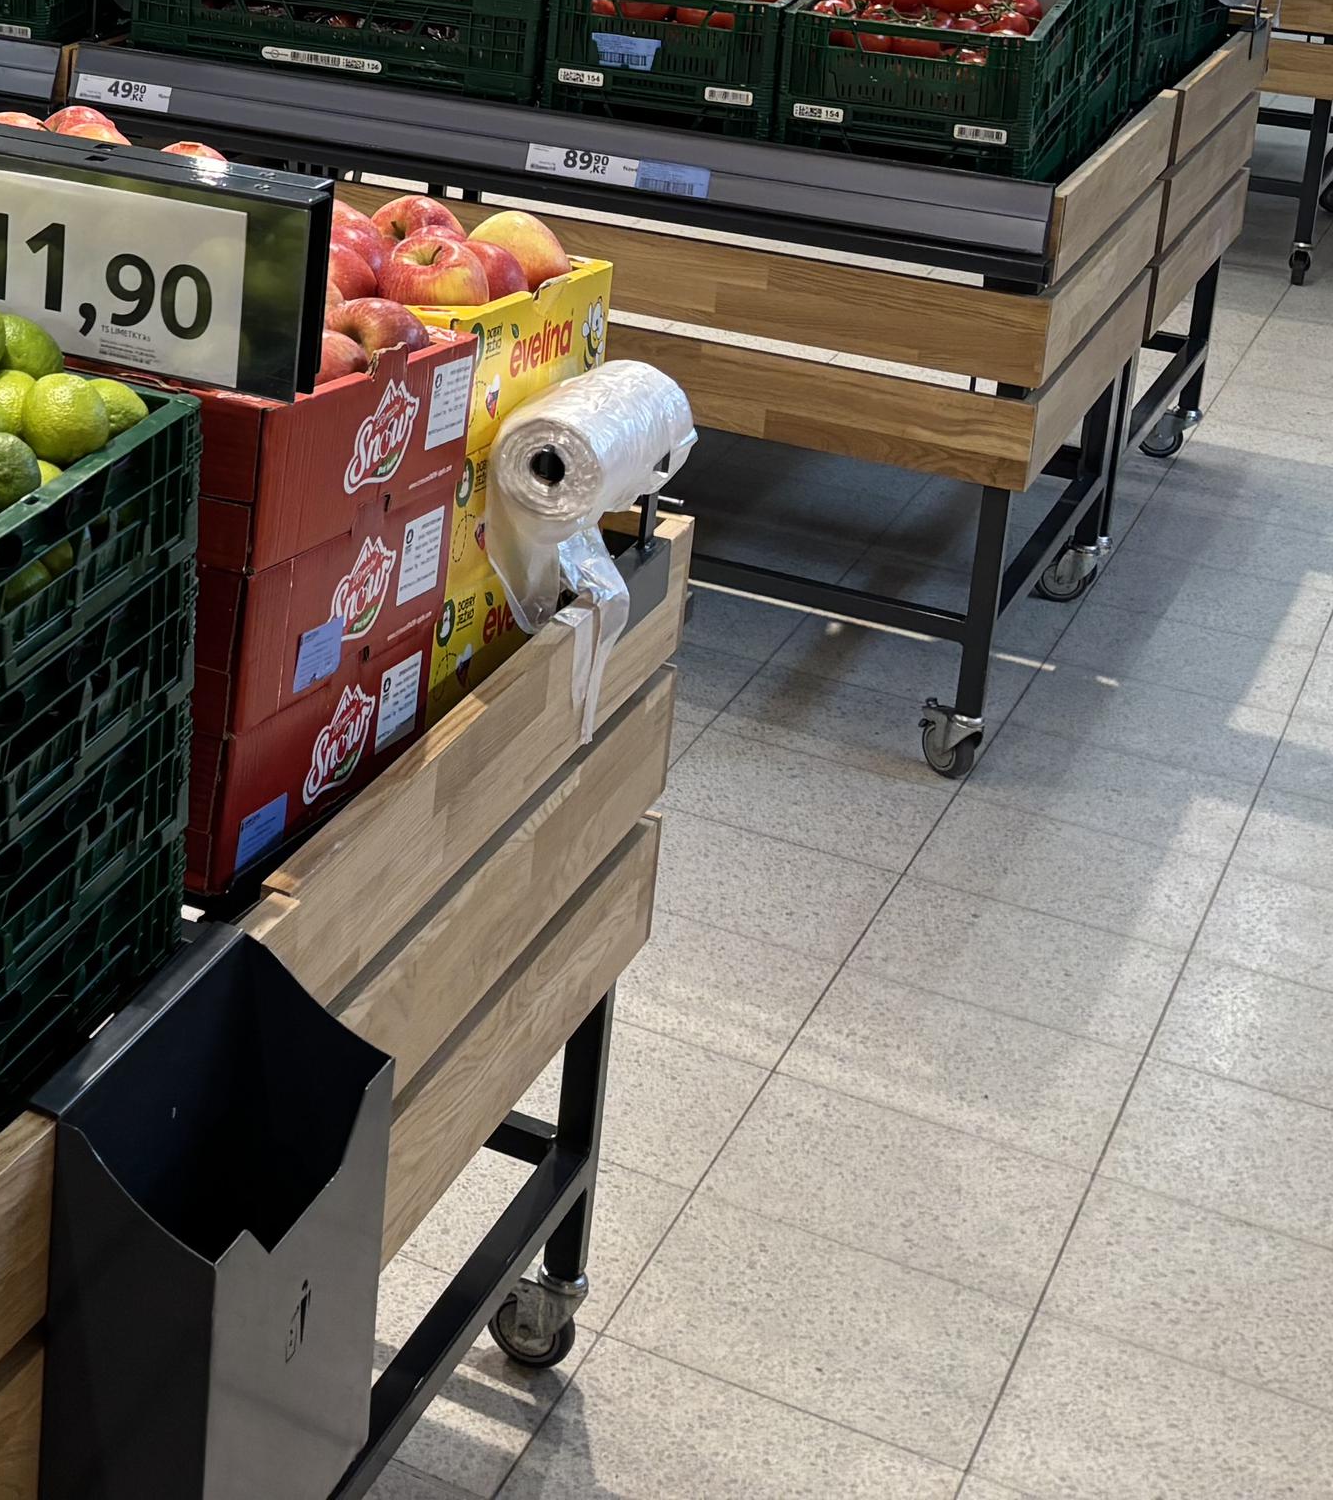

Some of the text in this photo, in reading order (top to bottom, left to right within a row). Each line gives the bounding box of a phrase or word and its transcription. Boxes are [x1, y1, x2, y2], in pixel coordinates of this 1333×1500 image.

[107, 79, 134, 98] 49
[563, 150, 593, 171] 89
[110, 326, 142, 340] LIMETKY
[509, 318, 574, 378] evelina
